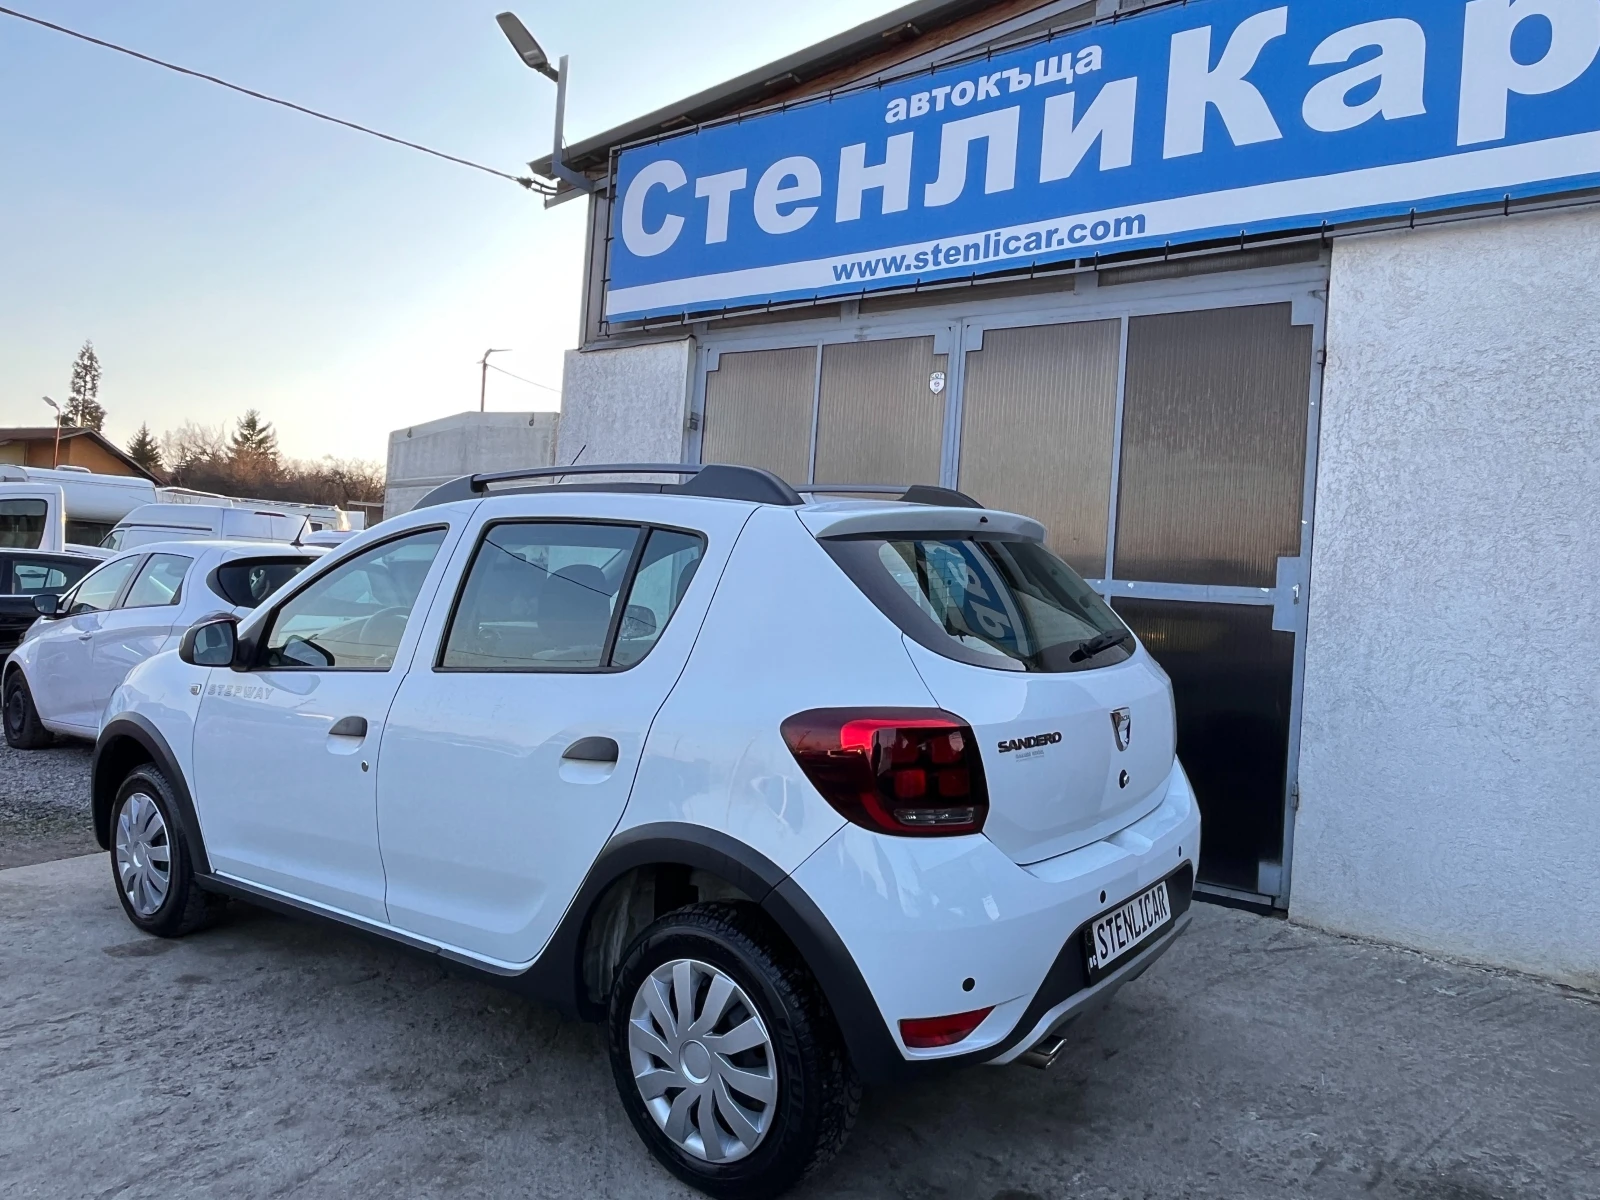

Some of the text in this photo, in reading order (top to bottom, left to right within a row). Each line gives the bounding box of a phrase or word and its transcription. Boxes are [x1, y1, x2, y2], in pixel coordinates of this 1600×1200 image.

[885, 45, 1102, 123] автокъща
[621, 0, 1600, 258] СтенлиКар
[832, 213, 1146, 282] www.stenlicar.com
[208, 684, 275, 700] STEPWAY
[998, 731, 1062, 753] SANDERO
[1097, 884, 1168, 960] STENLICAR
